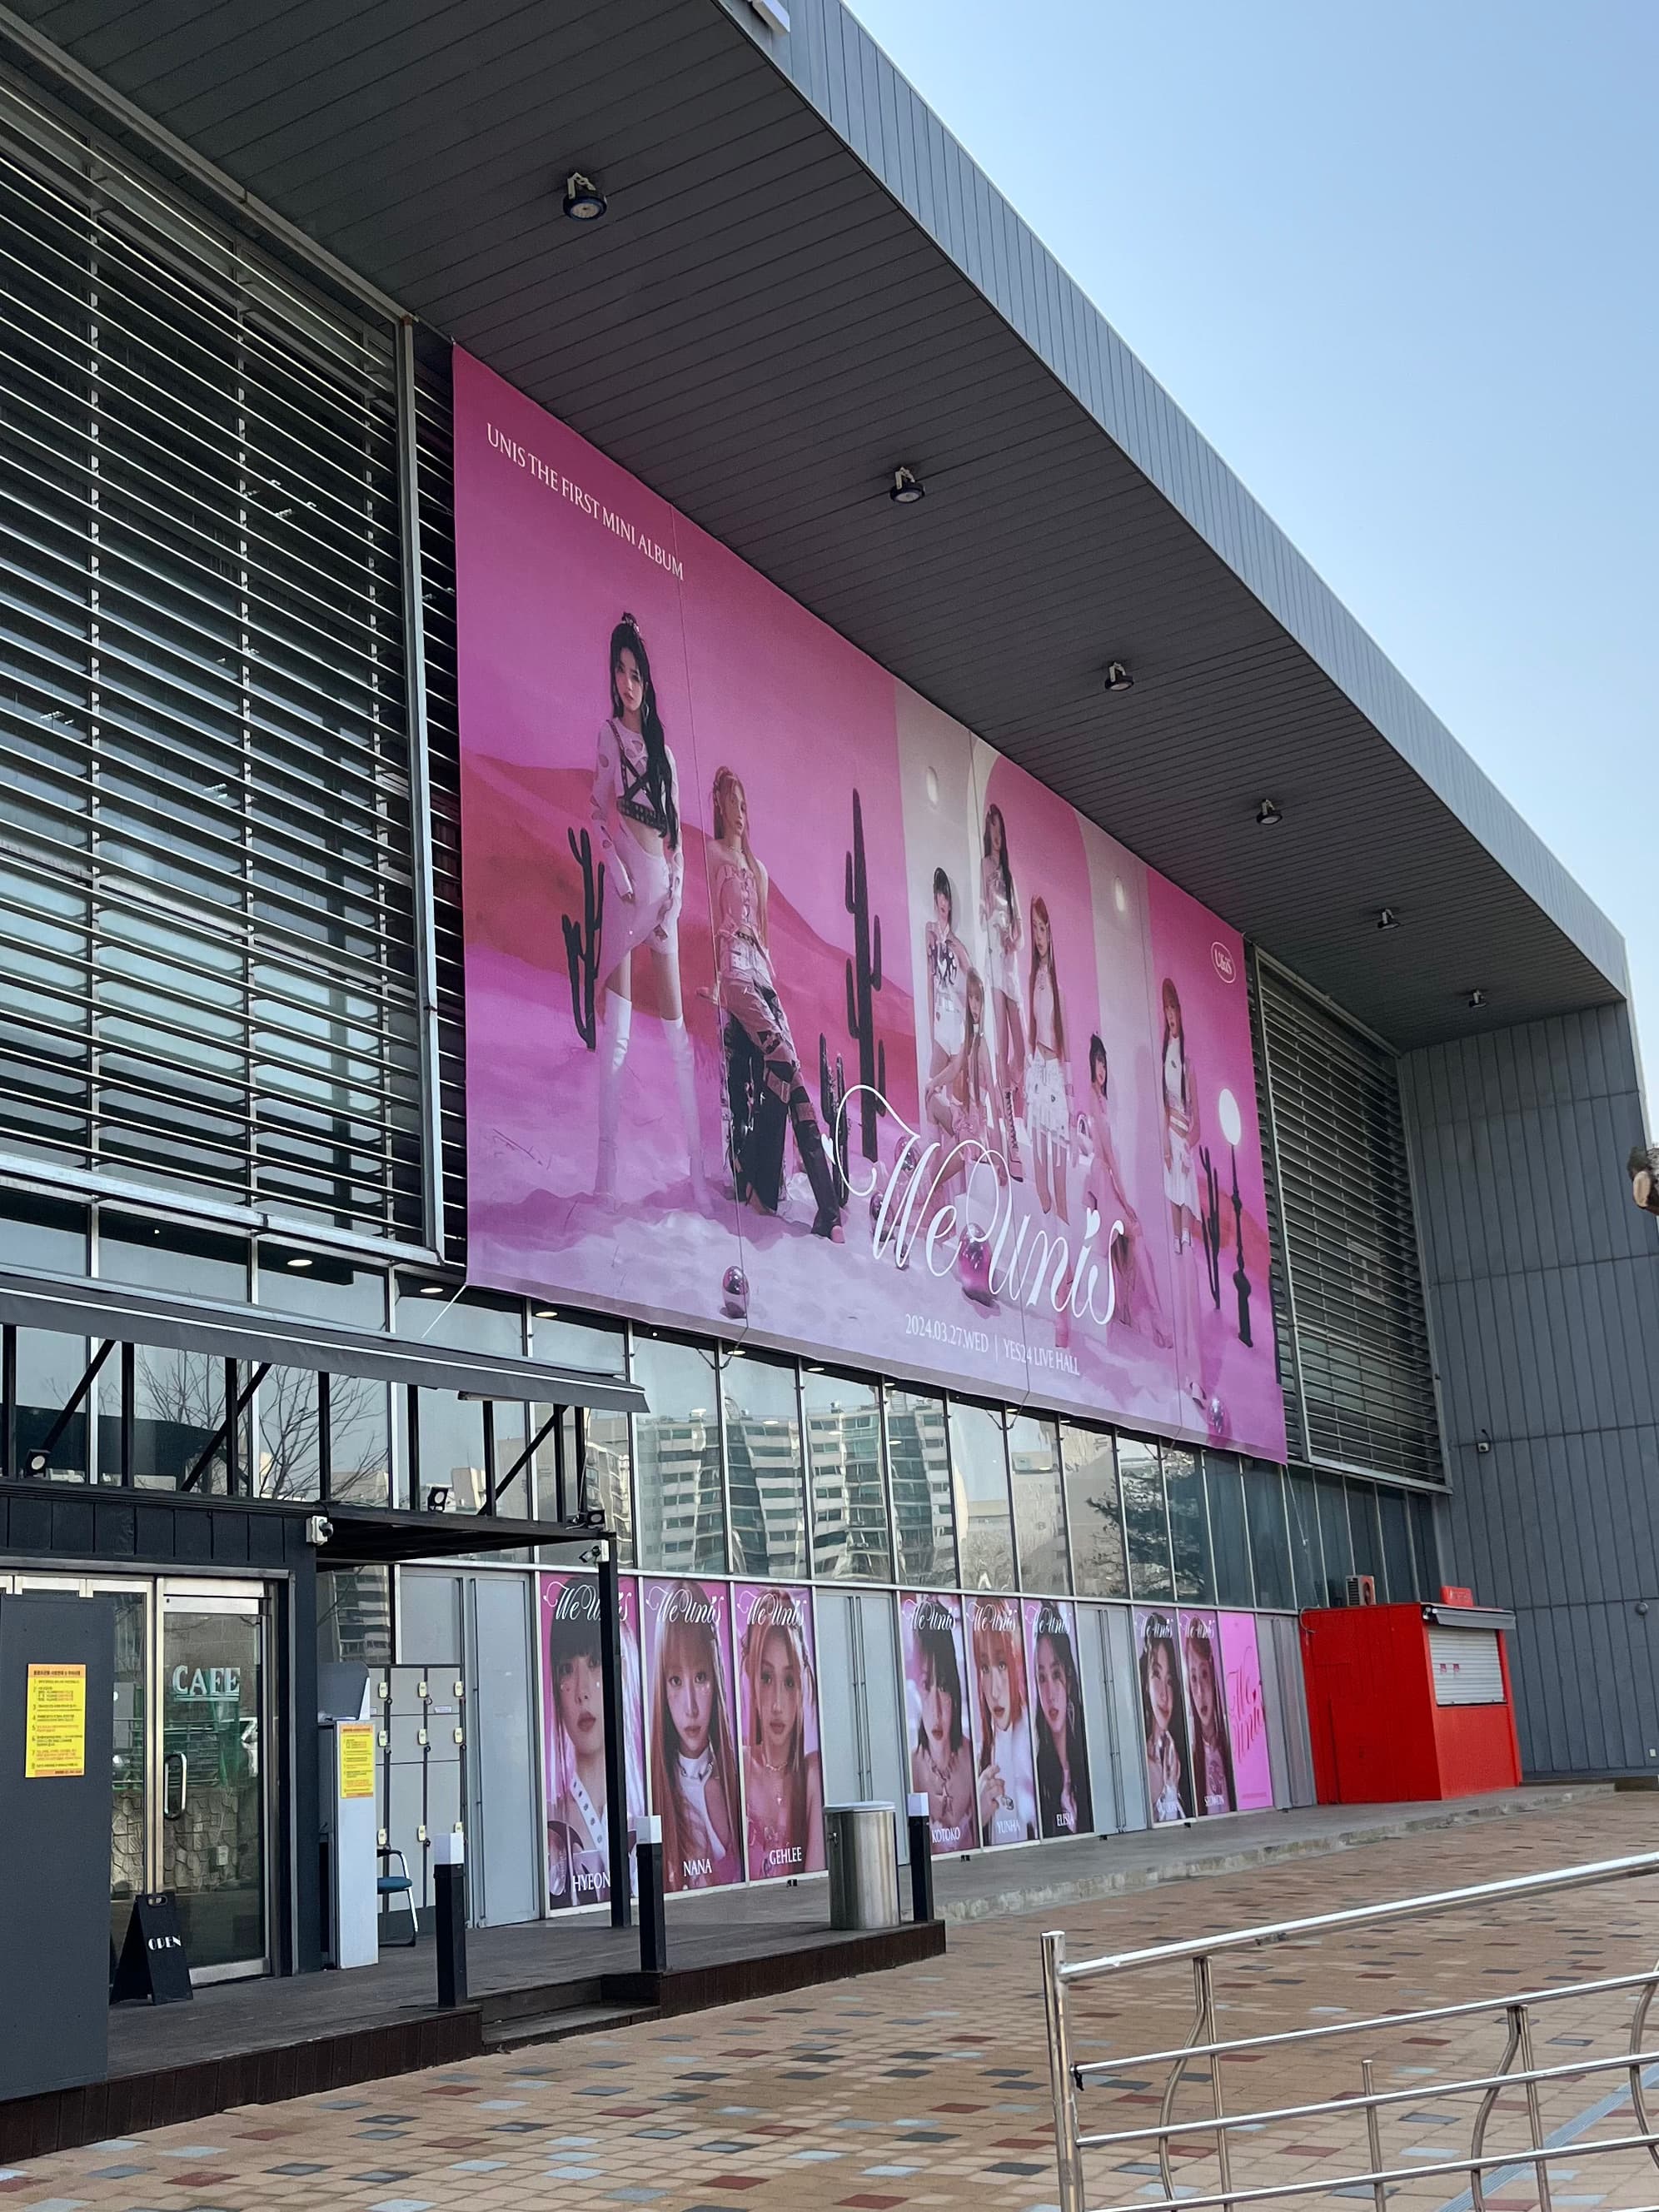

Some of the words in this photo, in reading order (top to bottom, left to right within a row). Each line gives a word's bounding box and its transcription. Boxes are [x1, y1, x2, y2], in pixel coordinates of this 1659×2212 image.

[486, 422, 526, 468] UNIS
[528, 452, 559, 491] THE
[561, 476, 600, 520] FIRST
[602, 506, 635, 546] MINI
[638, 533, 685, 581] ALBUM
[1003, 1338, 1034, 1365] YES24
[1034, 1348, 1054, 1370] LIVE
[1056, 1353, 1080, 1376] HALL
[172, 1664, 241, 1696] CAFE
[931, 1826, 960, 1844] KOTOKO
[683, 1858, 713, 1877] NANA
[769, 1846, 802, 1866] GEHLEE
